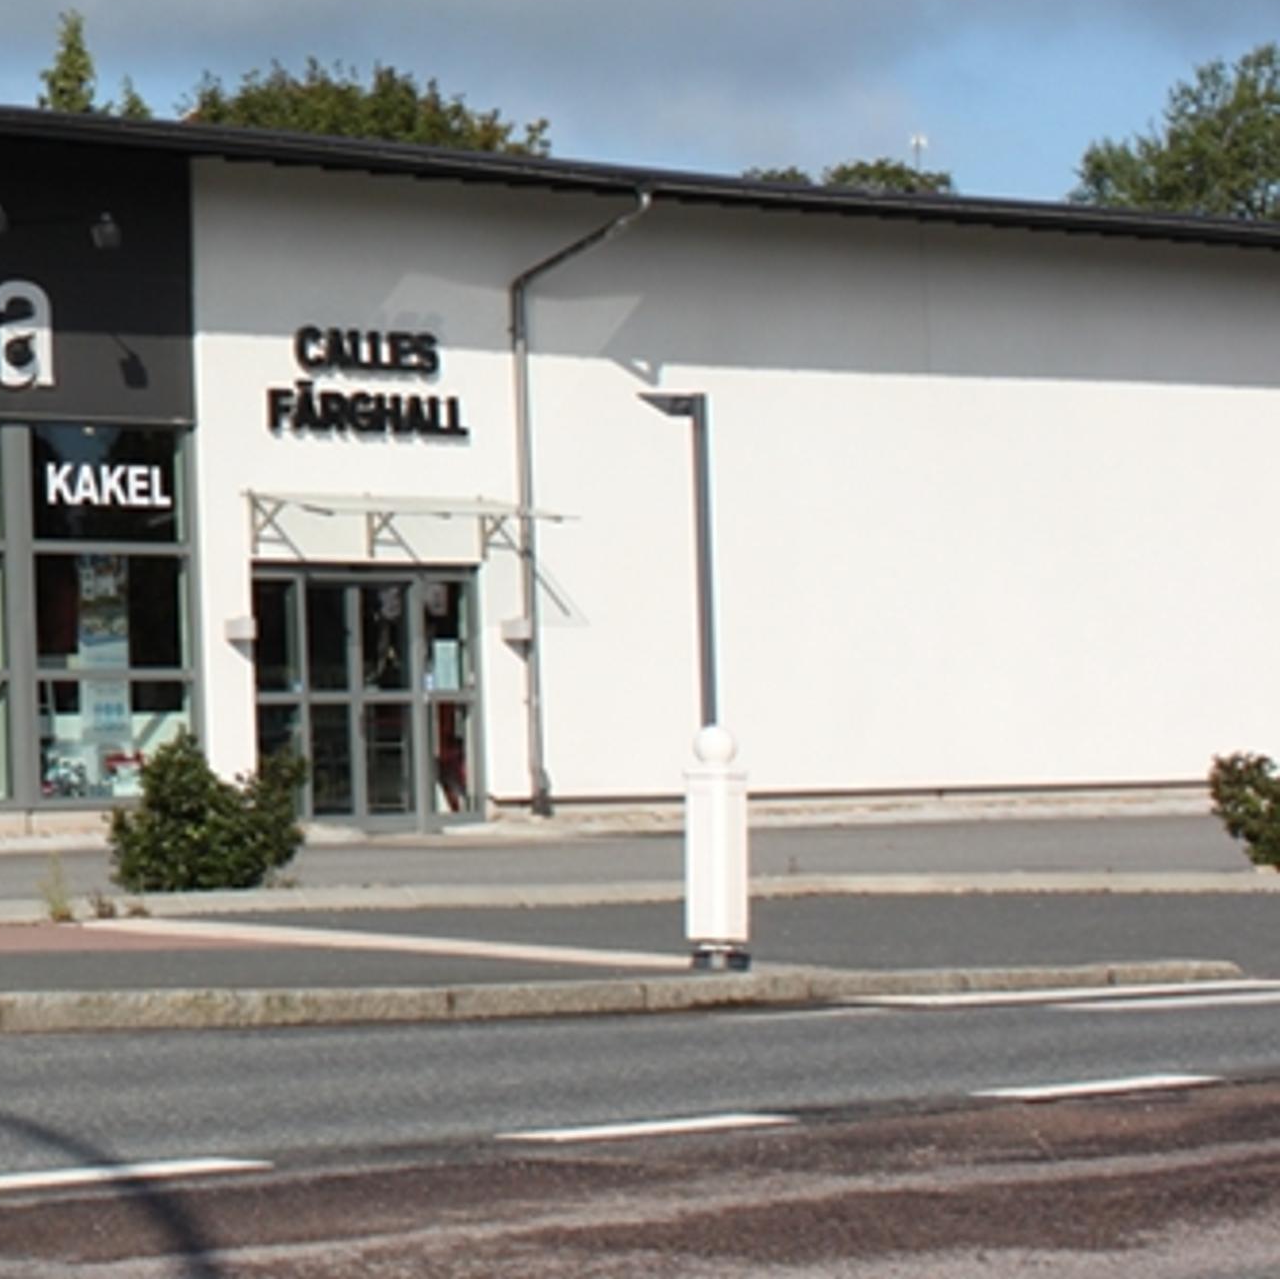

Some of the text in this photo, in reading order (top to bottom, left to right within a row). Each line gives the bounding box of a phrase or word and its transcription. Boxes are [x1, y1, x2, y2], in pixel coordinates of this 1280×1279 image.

[296, 325, 439, 377] CALLES
[267, 380, 468, 437] FÄRGHALL
[46, 463, 172, 507] KAKEL
